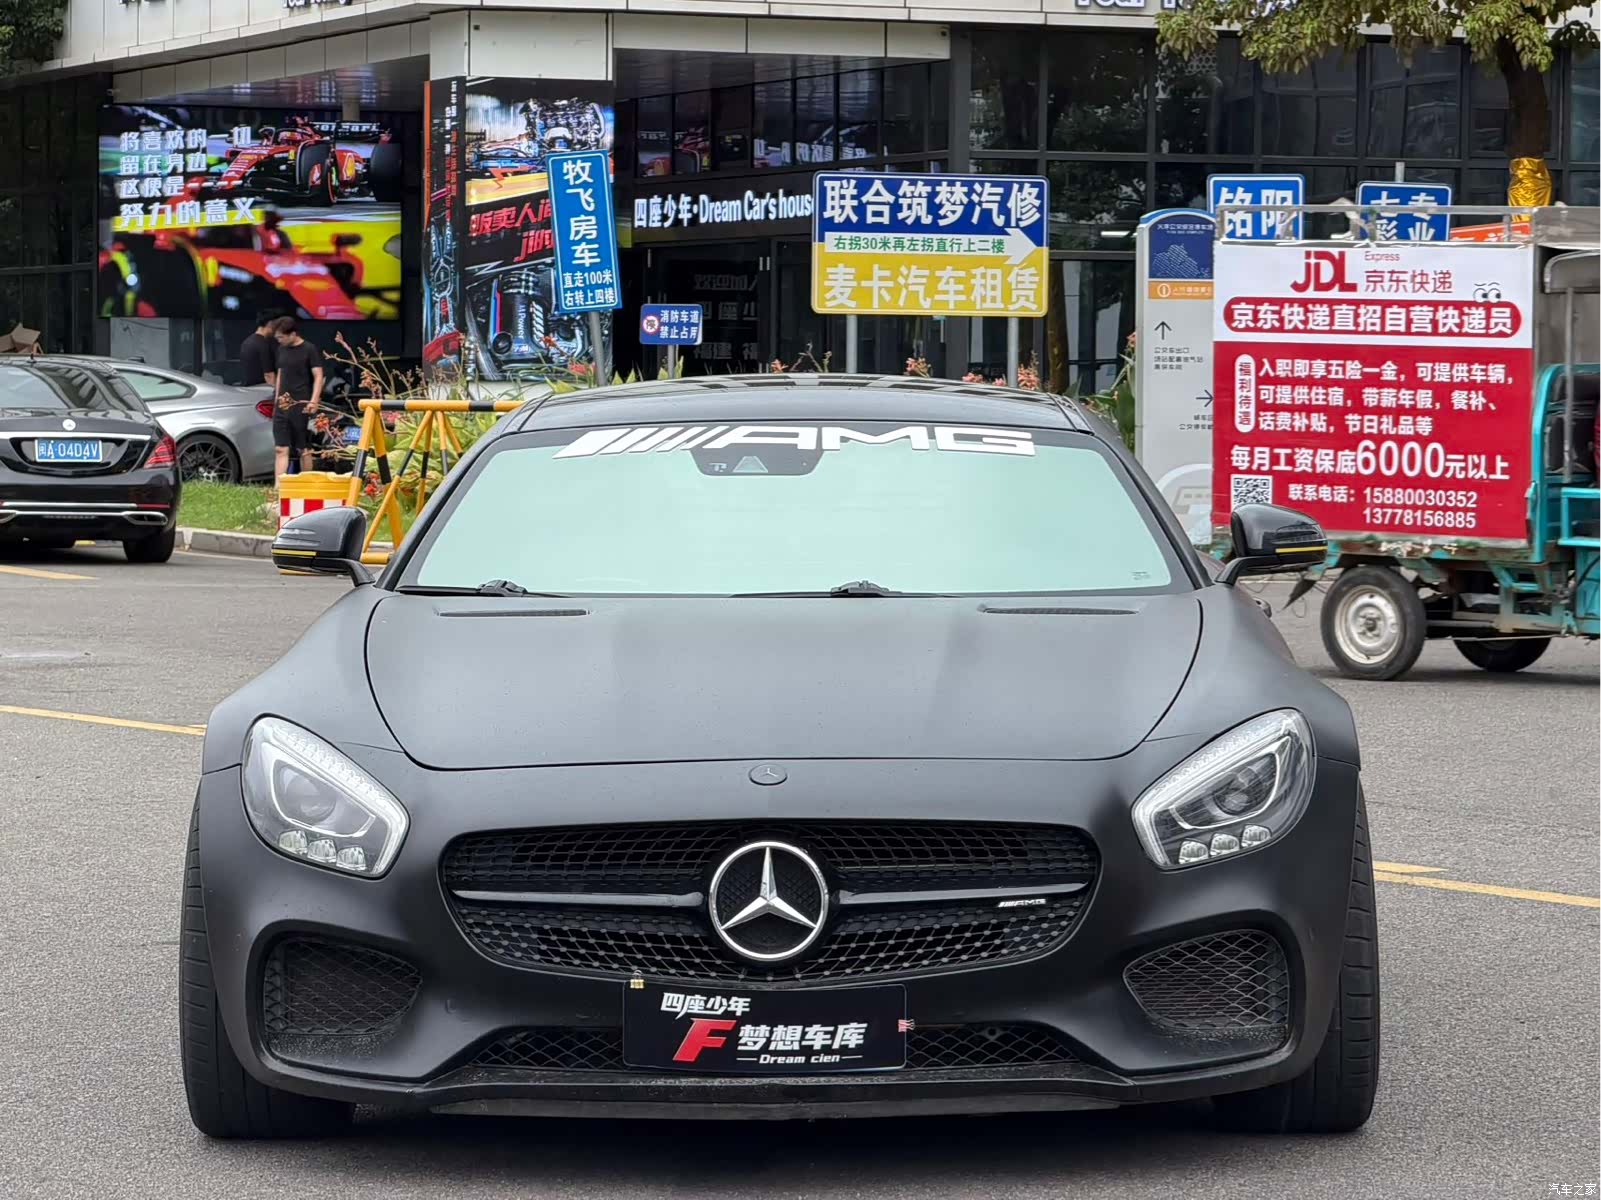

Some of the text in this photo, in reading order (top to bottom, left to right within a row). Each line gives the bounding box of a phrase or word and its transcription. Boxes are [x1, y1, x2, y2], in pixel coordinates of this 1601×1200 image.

[120, 126, 252, 152] 将喜欢的一切
[119, 152, 207, 175] 留在身边
[119, 176, 185, 199] 这便是
[119, 197, 255, 229] 努力的意义
[562, 159, 601, 267] 牧飞房车
[699, 194, 741, 224] Dream
[823, 179, 1042, 227] 联合筑梦汽修
[833, 235, 1006, 254] 右拐30米再左拐直行上二楼
[1364, 251, 1400, 262] Express
[563, 269, 613, 289] 直走100米
[1290, 250, 1358, 293] JDL
[1364, 269, 1453, 294] 京东快递
[564, 287, 615, 307] 右转上四楼
[823, 264, 1041, 311] 麦卡汽车租赁
[660, 310, 699, 324] 消防车道
[1230, 302, 1513, 336] 京东快递直招自营快递员
[1239, 361, 1251, 426] 福利待遇
[1230, 439, 1511, 481] 每月工资保底6000元以上
[1363, 487, 1478, 508] 15880030352
[1363, 508, 1477, 529] 13778156885
[660, 992, 751, 1020] 四座少年
[736, 1022, 868, 1051] 梦想车库
[758, 1054, 841, 1065] Dream cien
